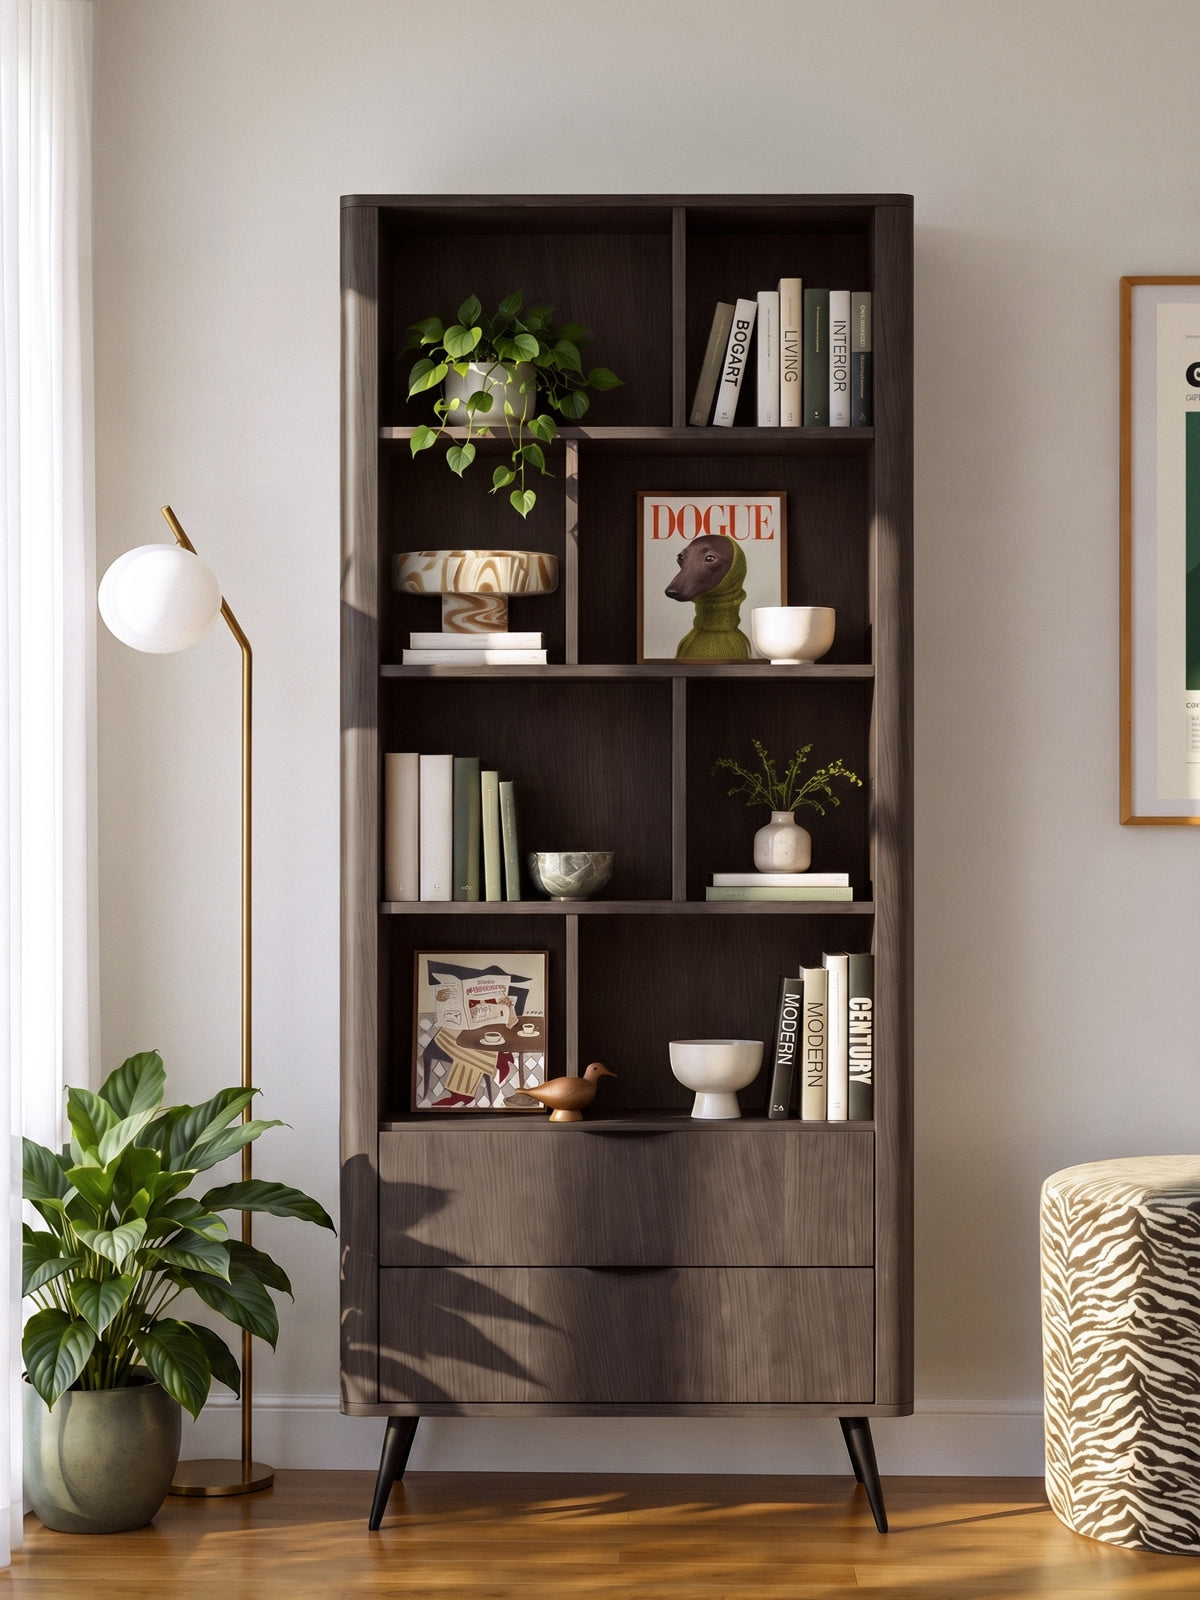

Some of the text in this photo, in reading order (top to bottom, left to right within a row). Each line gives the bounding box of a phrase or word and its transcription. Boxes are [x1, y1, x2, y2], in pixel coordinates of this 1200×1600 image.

[725, 320, 750, 387] BOGART
[784, 330, 799, 383] LIVING
[833, 320, 847, 392] INTERIOR
[651, 504, 774, 540] DOGUE
[777, 993, 801, 1065] MODERN
[807, 1002, 824, 1087] MODERN
[848, 997, 872, 1085] CENTURY
